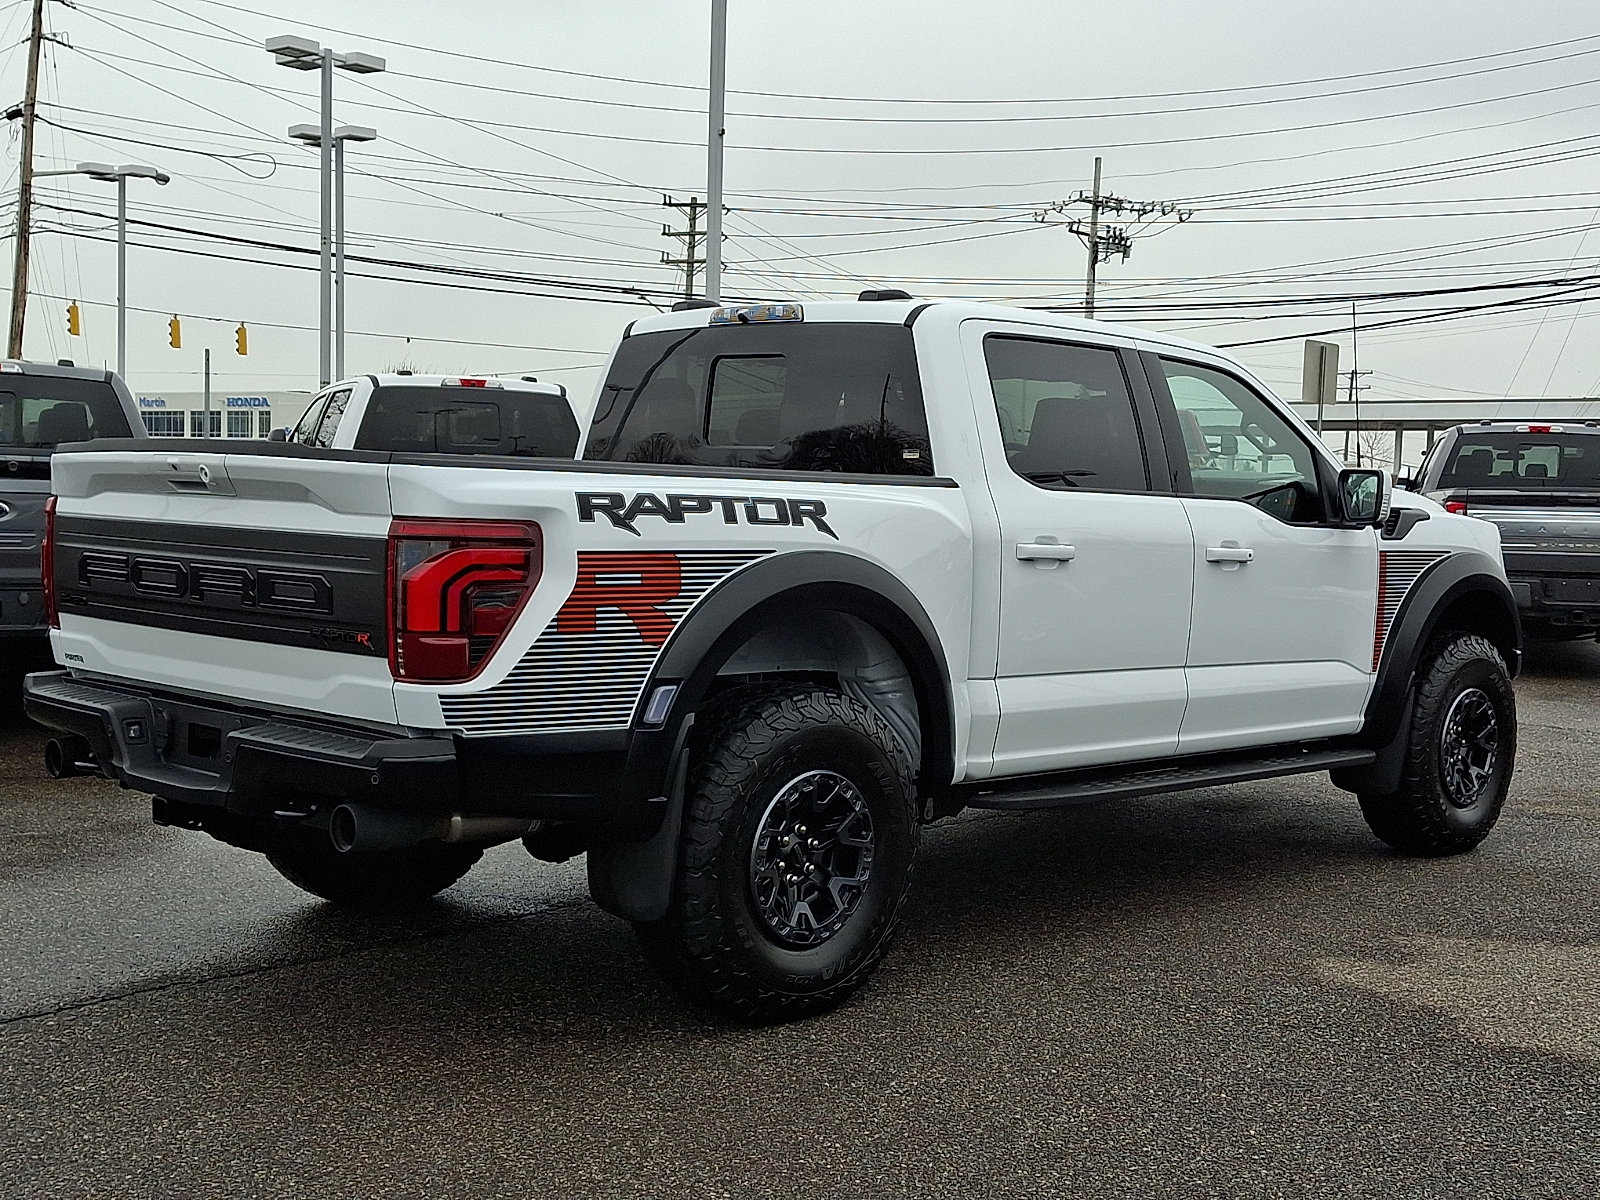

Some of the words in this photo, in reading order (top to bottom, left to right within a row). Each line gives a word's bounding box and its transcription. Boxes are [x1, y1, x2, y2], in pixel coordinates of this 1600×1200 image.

[139, 396, 166, 407] Martin
[226, 397, 270, 407] HONDA
[575, 491, 840, 541] RAPTOR
[78, 551, 333, 615] FORD
